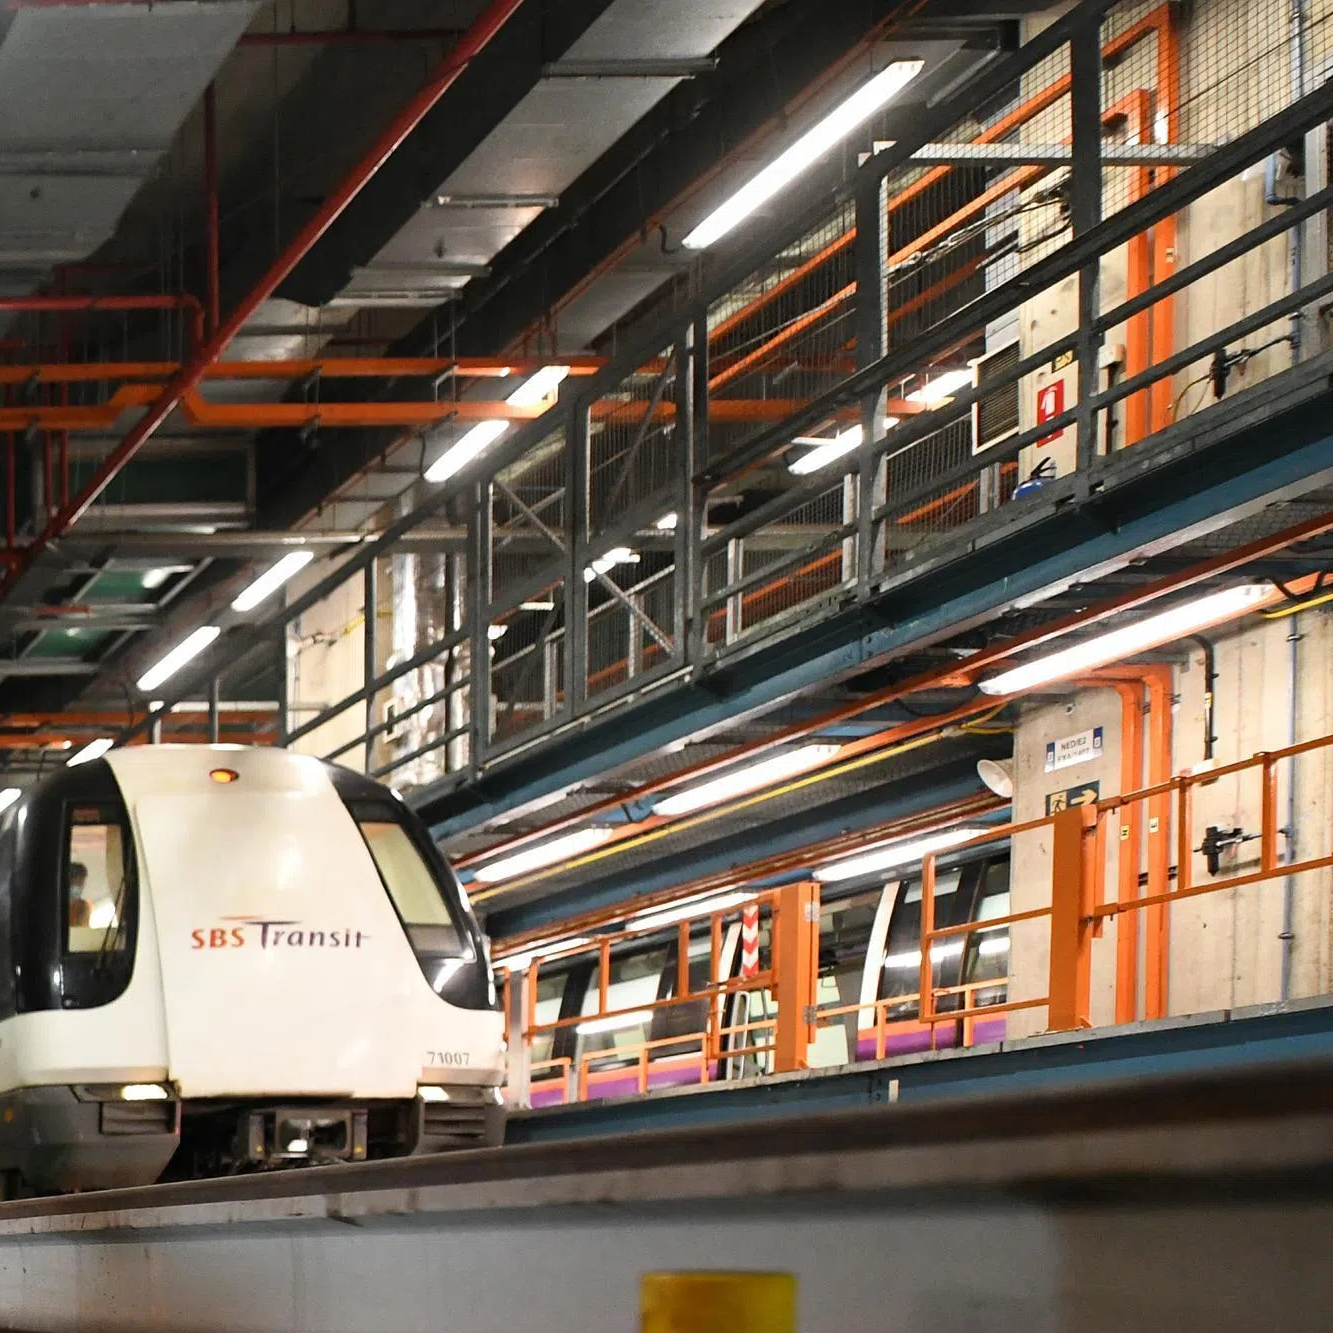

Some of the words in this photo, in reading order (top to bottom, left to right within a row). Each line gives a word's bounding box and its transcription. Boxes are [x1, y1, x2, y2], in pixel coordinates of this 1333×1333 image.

[191, 927, 246, 950] SBS
[242, 920, 373, 949] Transit
[427, 1051, 470, 1065] 71007
